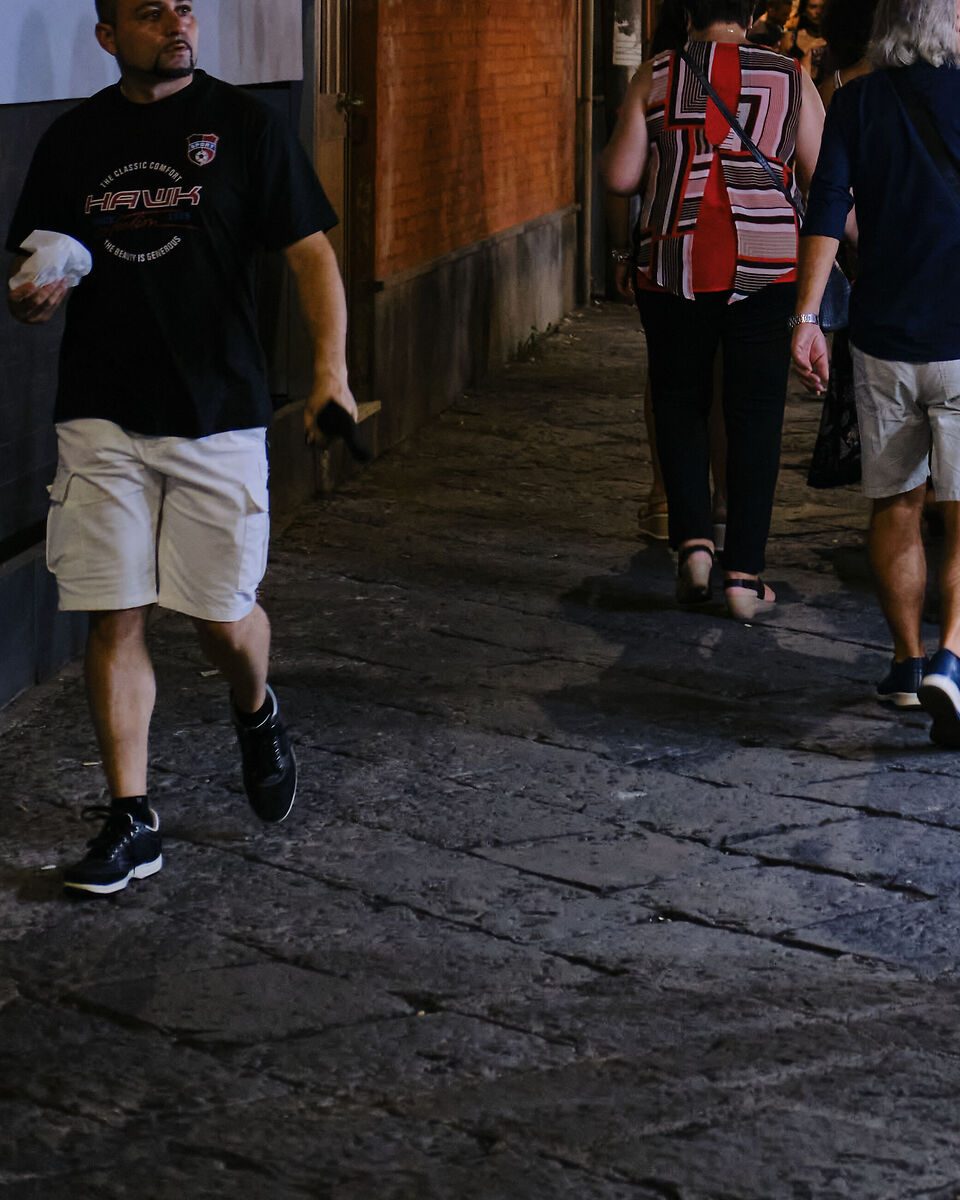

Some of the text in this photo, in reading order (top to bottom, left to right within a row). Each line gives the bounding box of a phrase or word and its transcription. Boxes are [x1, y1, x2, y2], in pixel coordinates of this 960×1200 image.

[100, 161, 183, 188] THE CLASSIC COMFORT
[84, 185, 202, 214] HAWK
[103, 235, 181, 263] THE BEAUTY IS GENEROUS
